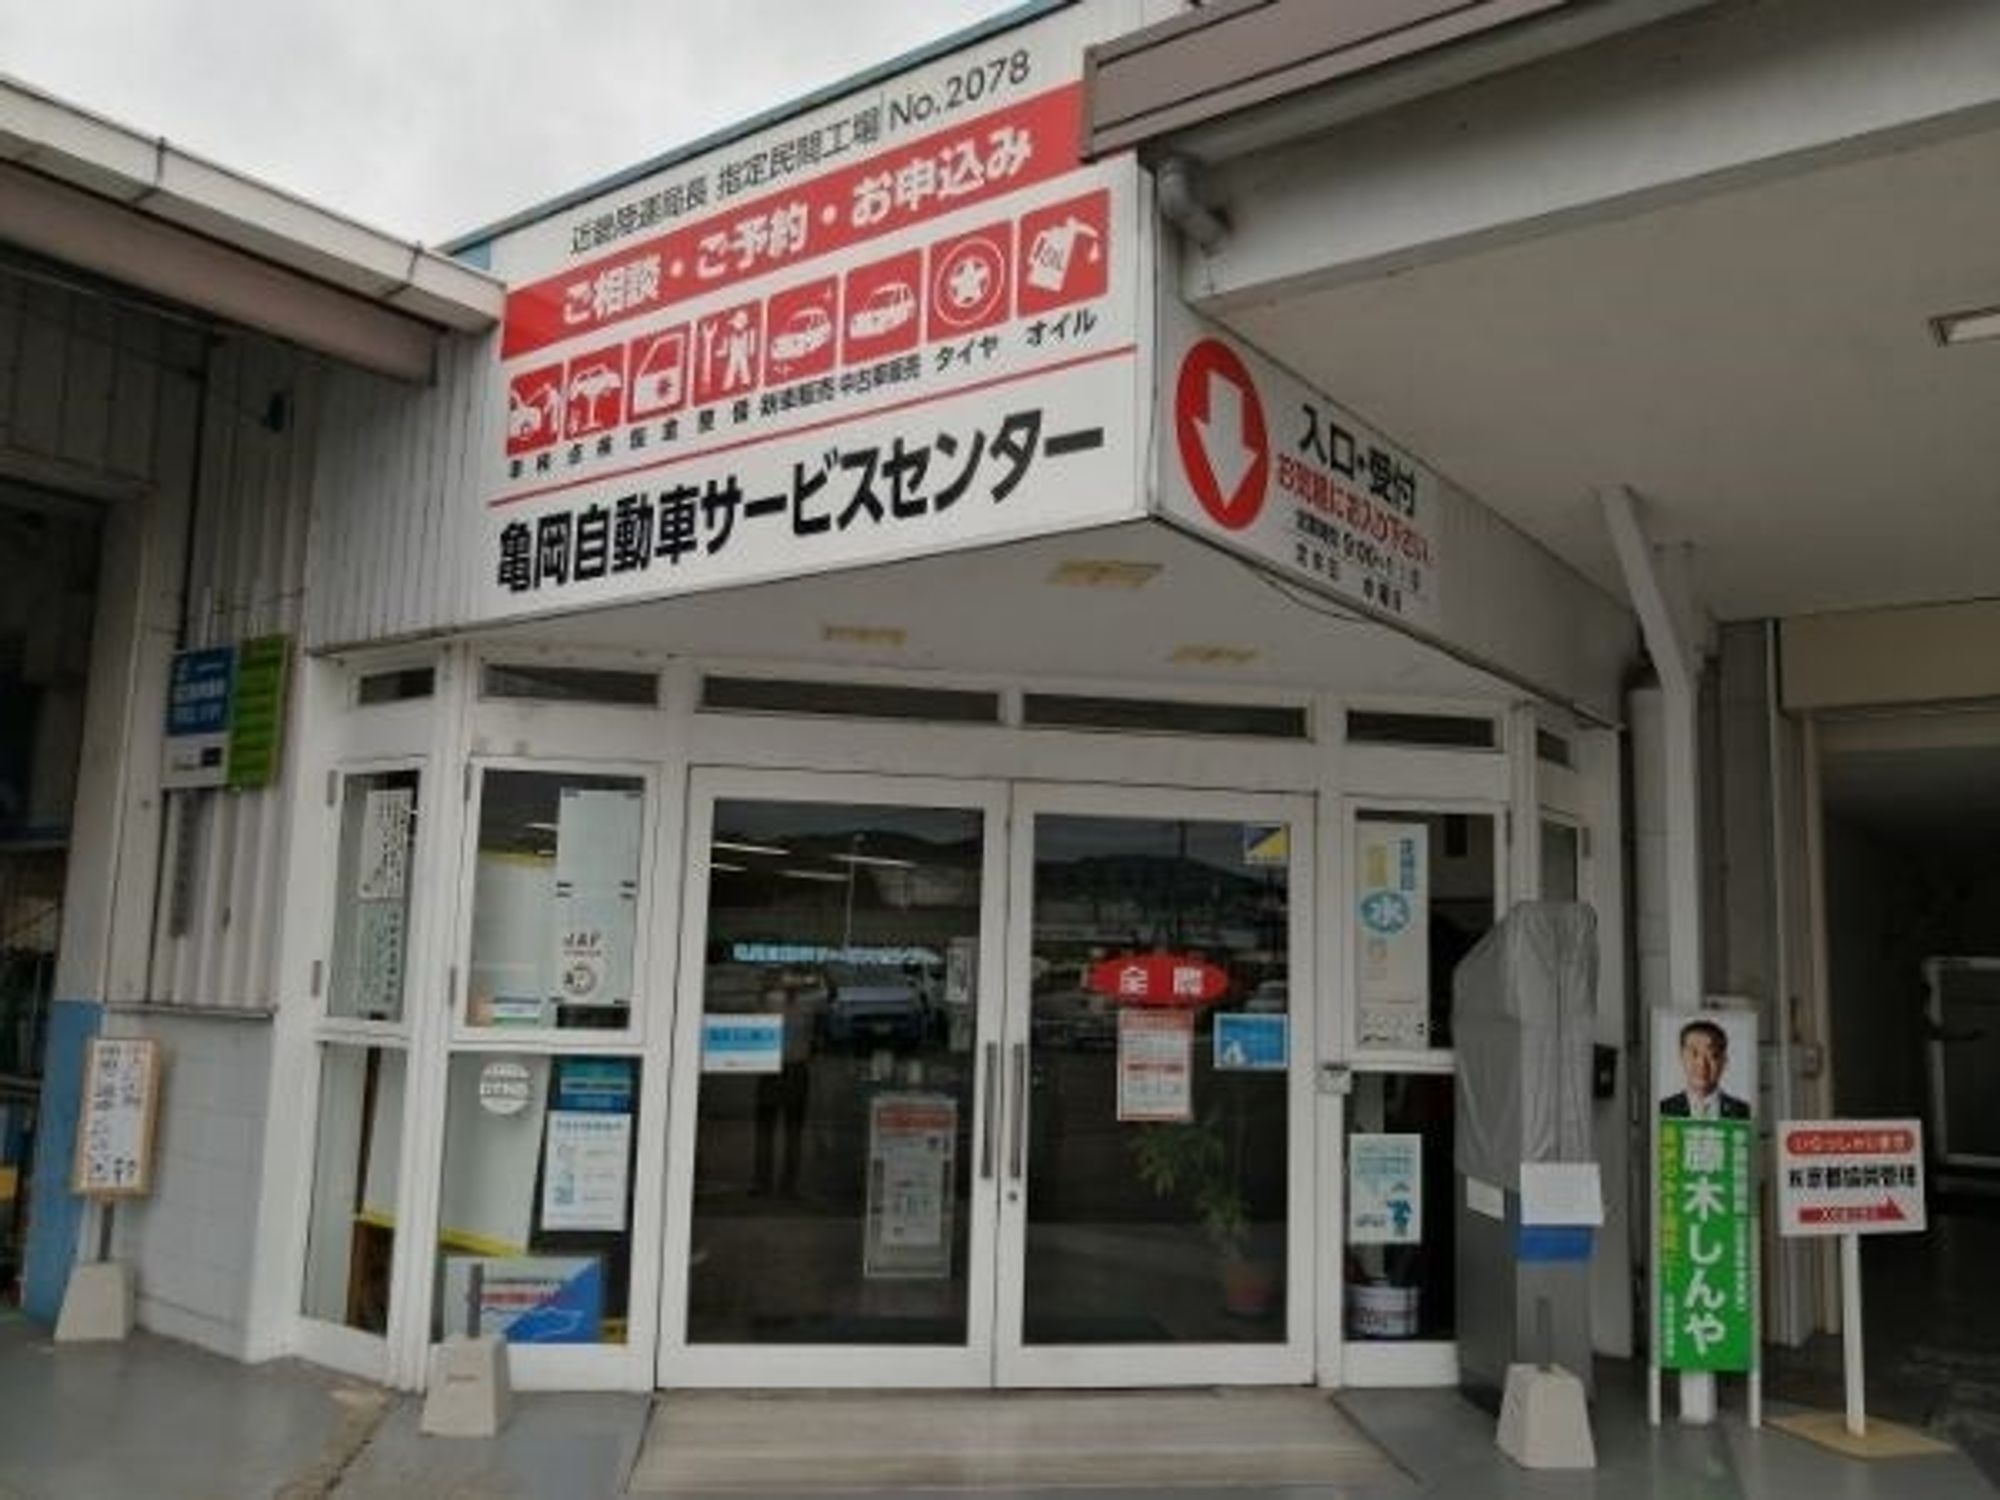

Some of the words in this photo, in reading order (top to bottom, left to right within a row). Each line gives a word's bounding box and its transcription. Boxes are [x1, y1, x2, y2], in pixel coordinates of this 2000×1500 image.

[888, 49, 1030, 131] No.2078
[563, 125, 1032, 324] ご相談・ご予約・お申込み
[935, 335, 999, 372] タイヤ
[1026, 308, 1098, 345] オイル
[497, 409, 1105, 592] 亀岡自動車サービスセンター
[1298, 403, 1416, 518] 入口・受付
